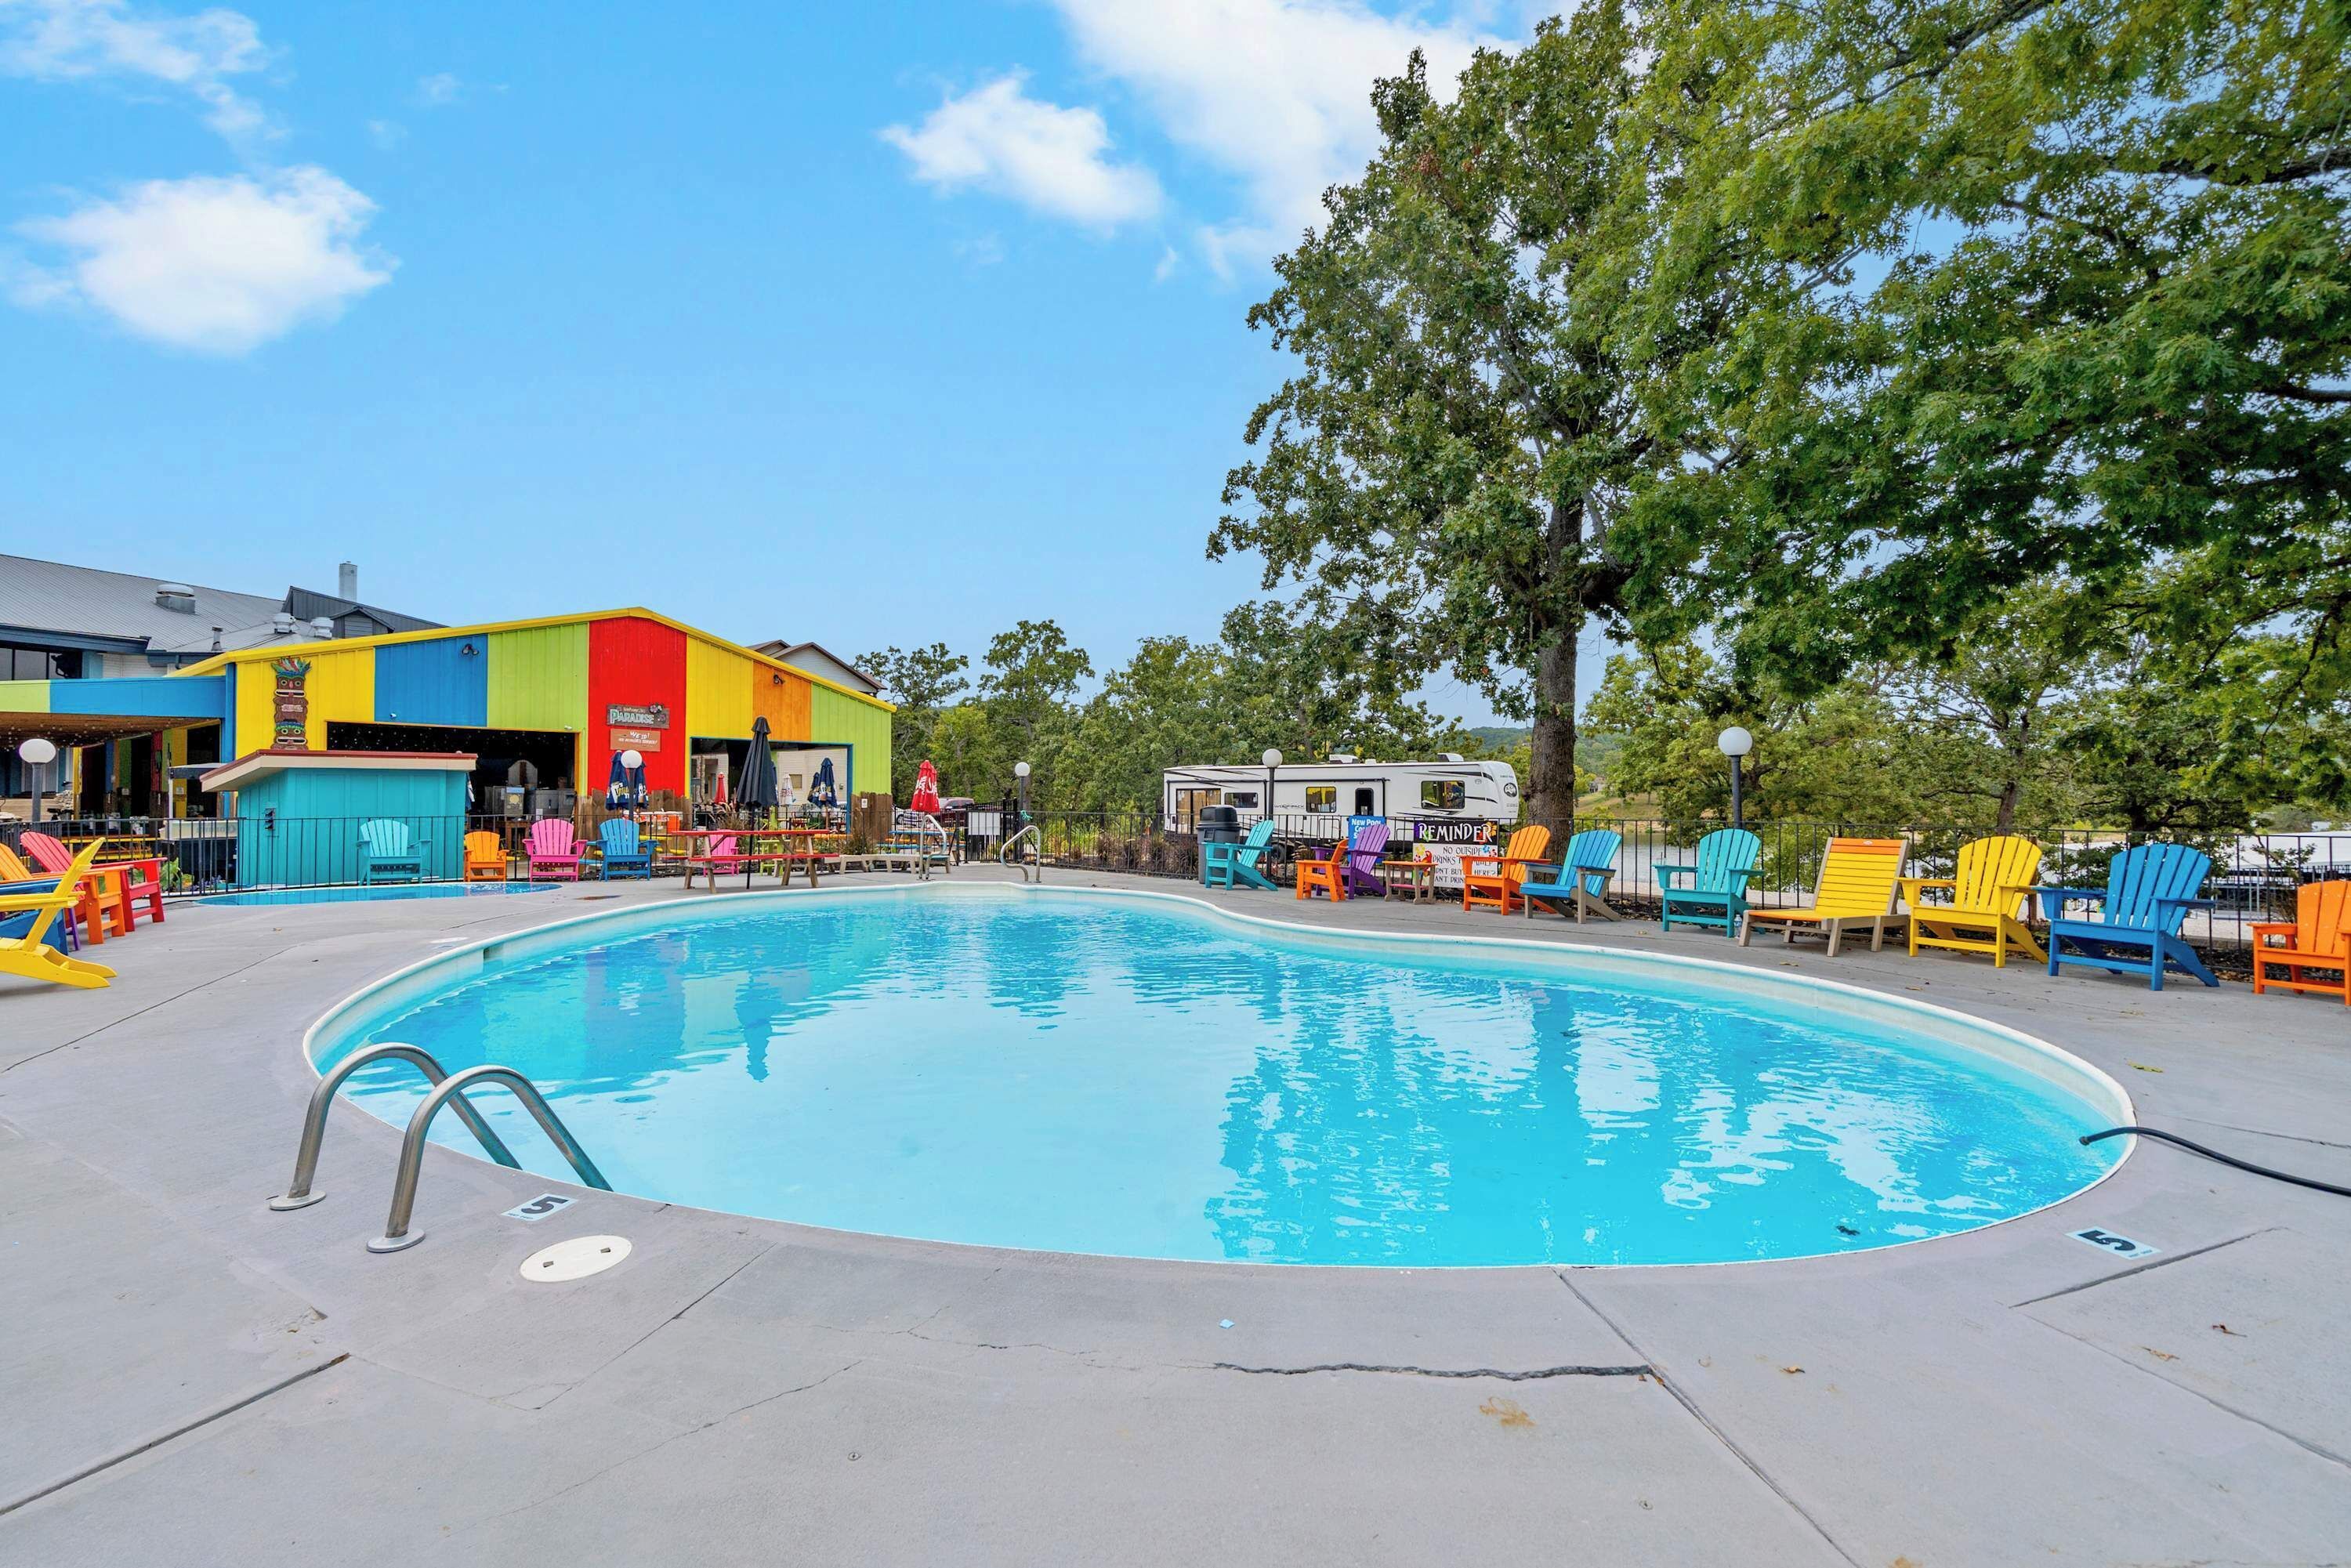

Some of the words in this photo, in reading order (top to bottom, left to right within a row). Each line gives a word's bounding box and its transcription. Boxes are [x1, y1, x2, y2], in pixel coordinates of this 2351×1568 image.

[610, 708, 654, 724] PARADISE
[1418, 823, 1493, 842] REMINDER
[1433, 856, 1456, 865] DRINKS
[520, 1196, 569, 1215] 5
[2078, 1229, 2136, 1251] 5
